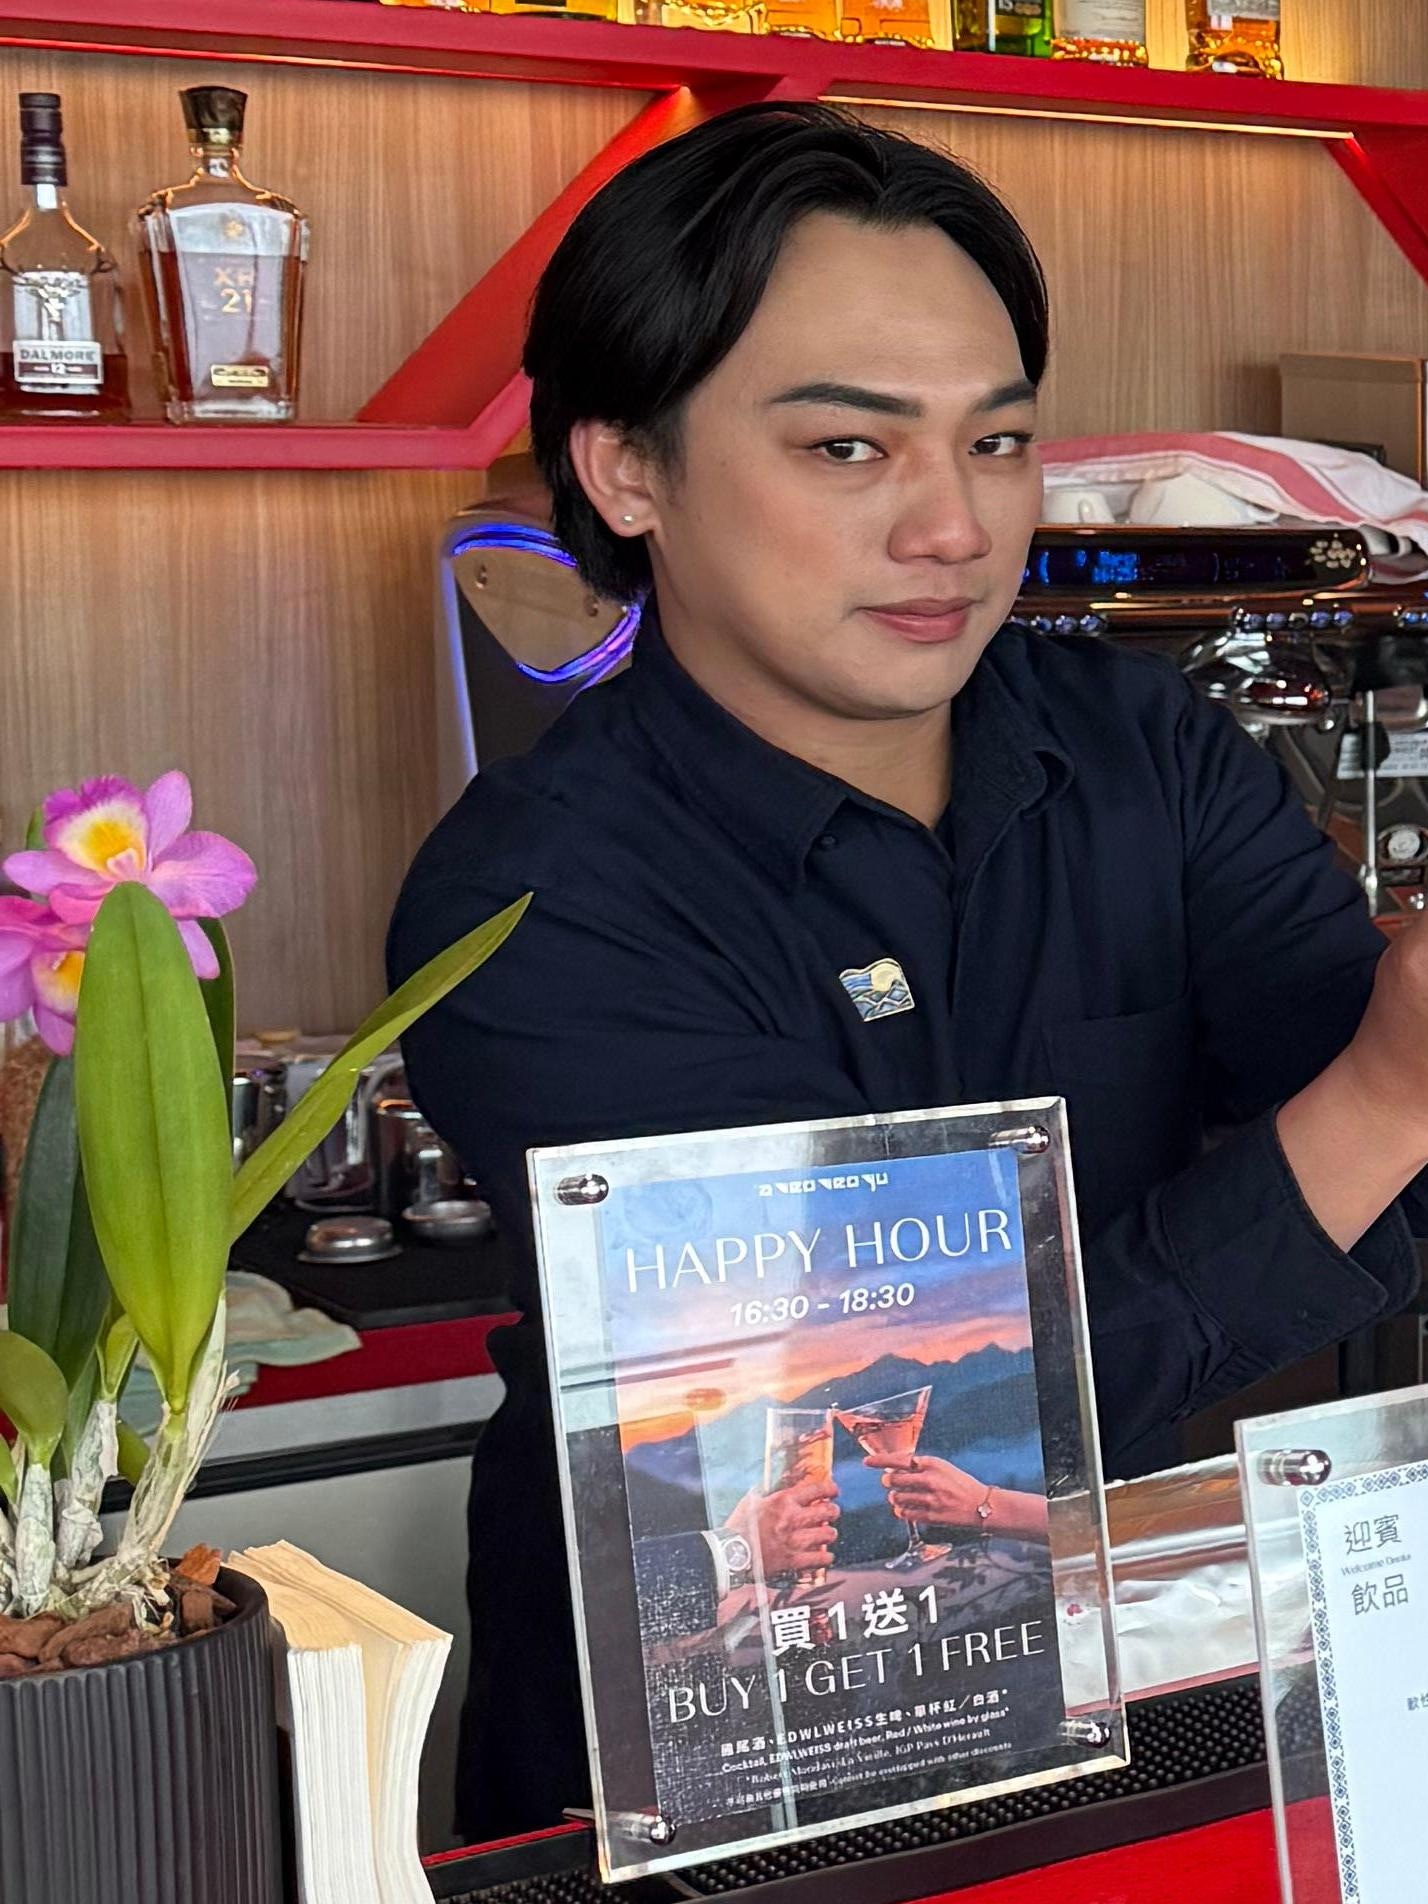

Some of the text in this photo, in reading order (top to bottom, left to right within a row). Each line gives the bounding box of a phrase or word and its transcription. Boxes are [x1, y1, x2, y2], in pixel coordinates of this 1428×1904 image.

[220, 288, 253, 313] 21
[20, 347, 96, 362] DALMORE
[626, 1209, 1012, 1293] HAPPY HOUR
[730, 1295, 809, 1326] 16:30
[839, 1283, 915, 1314] 18:30
[1343, 1513, 1402, 1555] 迎賓
[1351, 1573, 1409, 1616] 飲品
[668, 1620, 1044, 1724] BUY 1 GET 1 FREE
[886, 1728, 906, 1740] Red
[913, 1722, 942, 1734] White
[943, 1717, 966, 1729] wine
[967, 1713, 979, 1724] by
